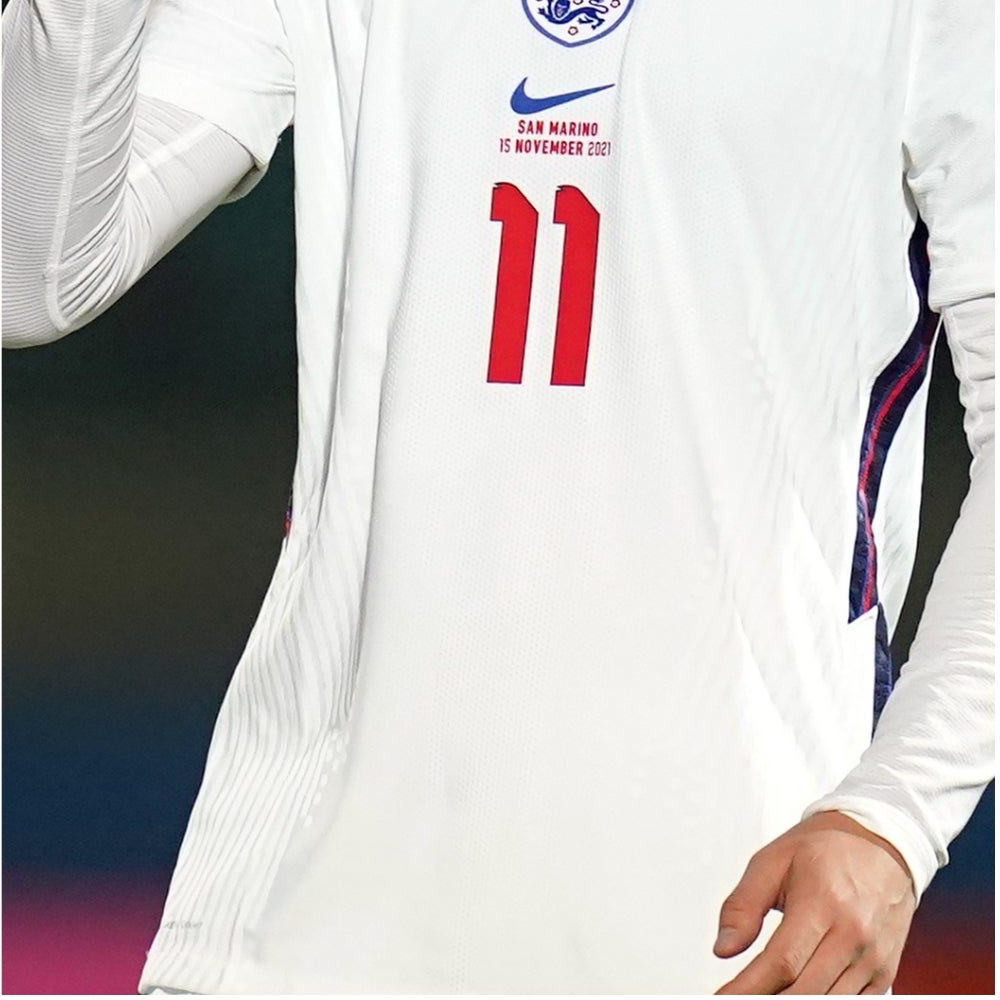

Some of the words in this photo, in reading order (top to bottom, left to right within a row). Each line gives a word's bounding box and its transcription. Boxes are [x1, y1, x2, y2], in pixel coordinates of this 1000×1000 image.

[517, 119, 544, 135] SAN
[549, 121, 599, 137] MARINO
[500, 138, 511, 153] 15
[515, 139, 584, 156] NOVEMBER
[588, 141, 611, 156] 2021
[486, 181, 600, 387] 11
